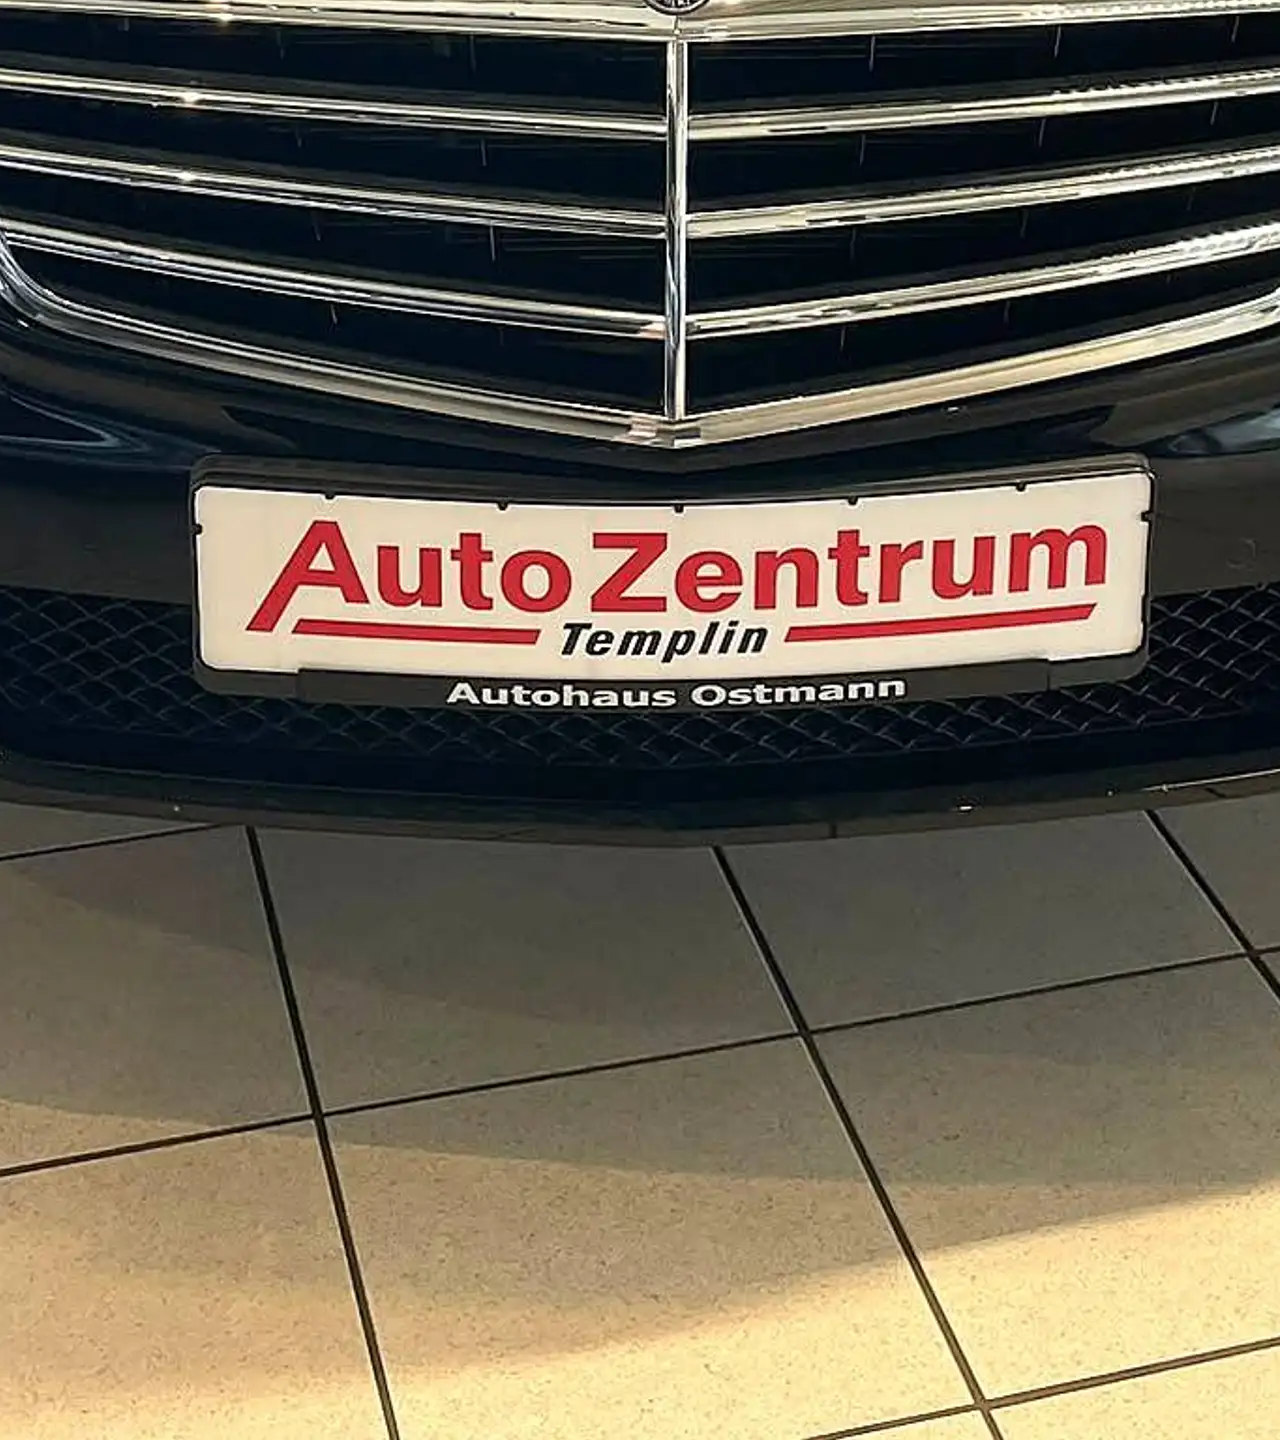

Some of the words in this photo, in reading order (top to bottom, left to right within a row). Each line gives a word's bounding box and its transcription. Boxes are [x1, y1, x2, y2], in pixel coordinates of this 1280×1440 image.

[245, 519, 573, 633] Auto
[590, 524, 1108, 613] Zentrum
[560, 620, 770, 663] Templin
[446, 681, 678, 709] Autohaus
[690, 677, 907, 707] Ostmann
